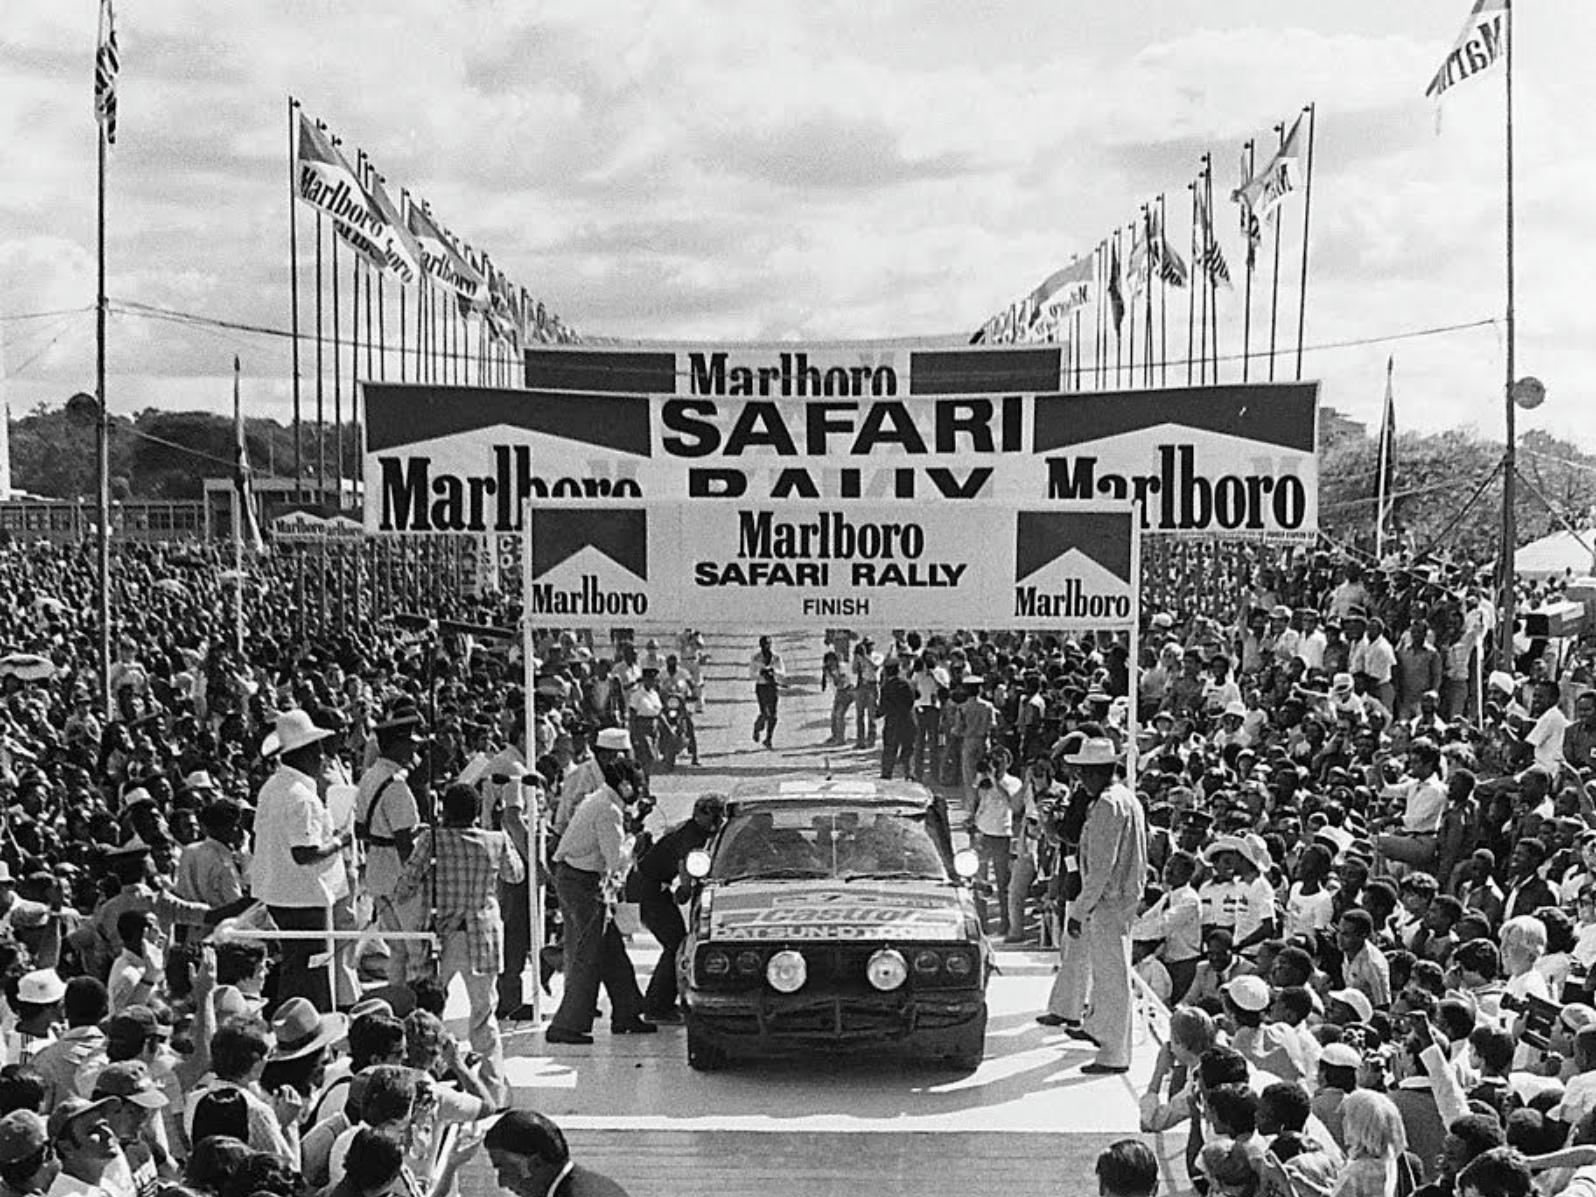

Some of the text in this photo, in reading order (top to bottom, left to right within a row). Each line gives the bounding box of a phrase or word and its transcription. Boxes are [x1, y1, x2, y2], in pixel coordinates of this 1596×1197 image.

[300, 165, 383, 239] Marlboro
[688, 352, 897, 396] Marlboro
[661, 397, 1023, 458] SAFARI
[737, 510, 925, 559] Marlboro
[532, 574, 648, 615] Marlboro
[694, 562, 968, 587] SAFARI RALLY
[803, 598, 869, 615] FINISH
[1014, 578, 1131, 618] Marlboro
